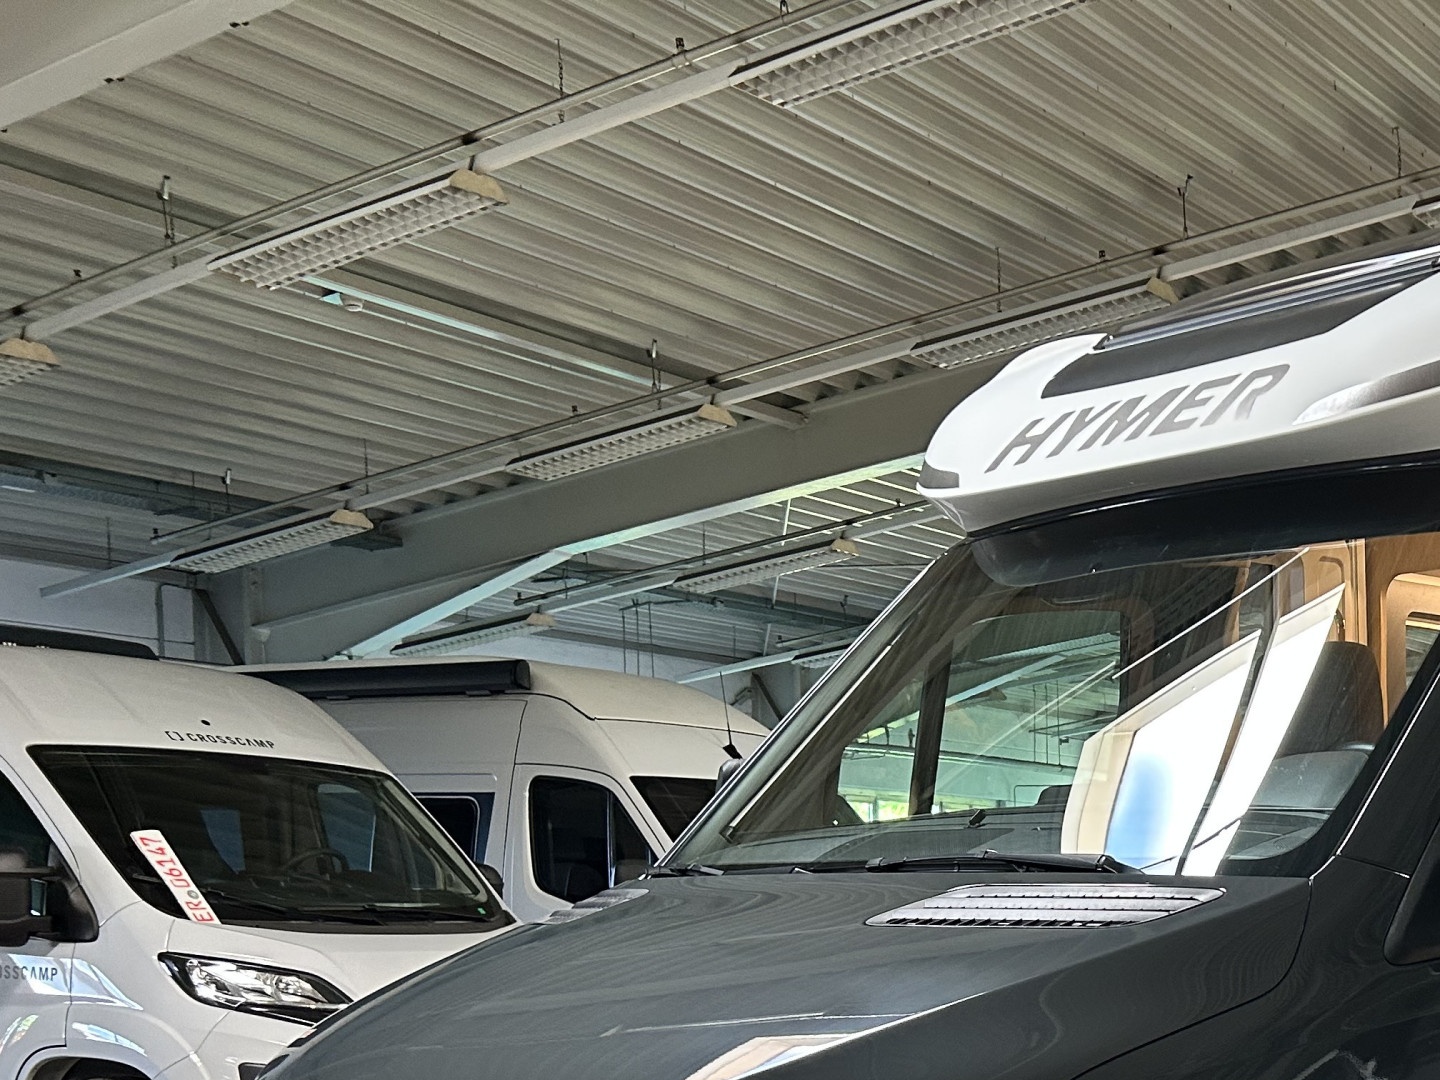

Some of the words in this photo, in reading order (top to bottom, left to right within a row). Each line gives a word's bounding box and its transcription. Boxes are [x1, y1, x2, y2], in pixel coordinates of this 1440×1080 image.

[984, 363, 1290, 474] HYMER
[186, 732, 275, 749] CROSSCAMP
[139, 836, 191, 888] 06147
[184, 900, 215, 922] ER
[0, 964, 58, 982] SSCAMP
